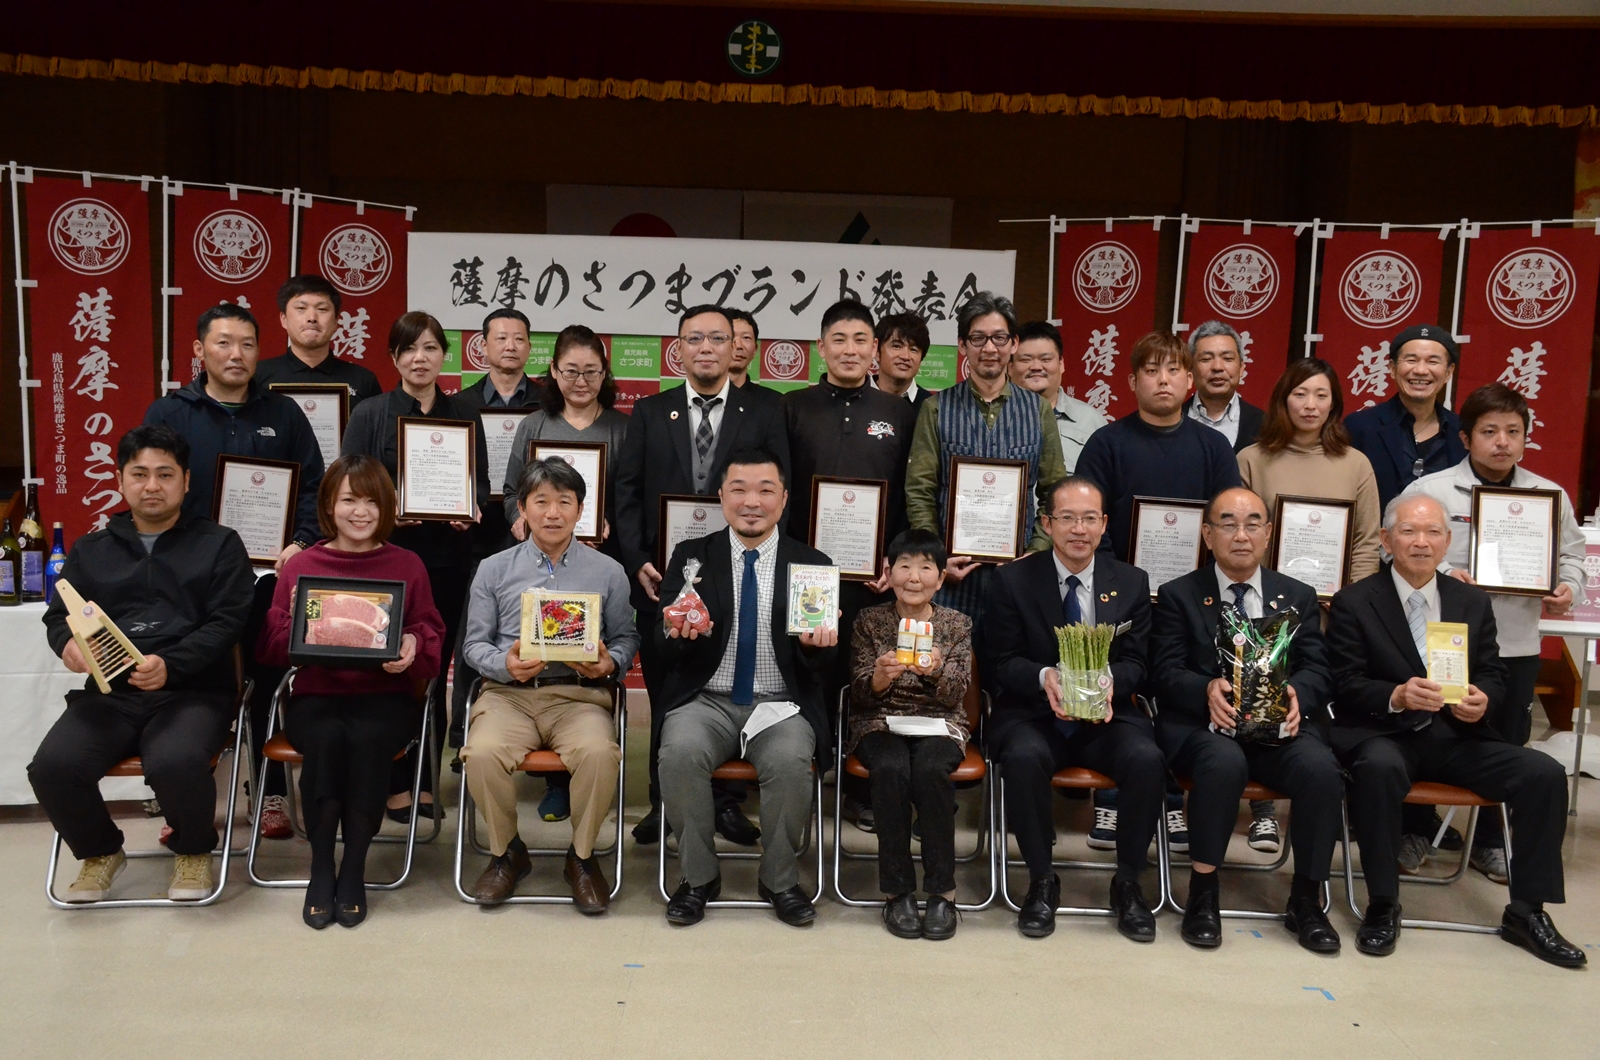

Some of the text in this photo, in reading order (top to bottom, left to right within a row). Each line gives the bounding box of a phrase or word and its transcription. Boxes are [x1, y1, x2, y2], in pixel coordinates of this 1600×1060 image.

[85, 221, 94, 229] の
[76, 229, 102, 240] さつま
[229, 231, 237, 239] の
[220, 239, 245, 251] さつま
[344, 253, 369, 264] さつま
[1103, 262, 1111, 270] の
[1095, 270, 1117, 280] さつま
[1229, 274, 1254, 284] さつま
[1376, 273, 1385, 281] の
[1527, 271, 1536, 280] の
[1367, 282, 1392, 292] さつま
[1516, 280, 1545, 291] さつま
[530, 347, 550, 355] 児島県
[526, 356, 553, 365] つま町
[619, 357, 654, 368] さつま町
[191, 357, 203, 382] 鹿児
[1347, 340, 1392, 412] 薩
[52, 352, 67, 494] 鹿児島県薩摩郡さつま町の逸品
